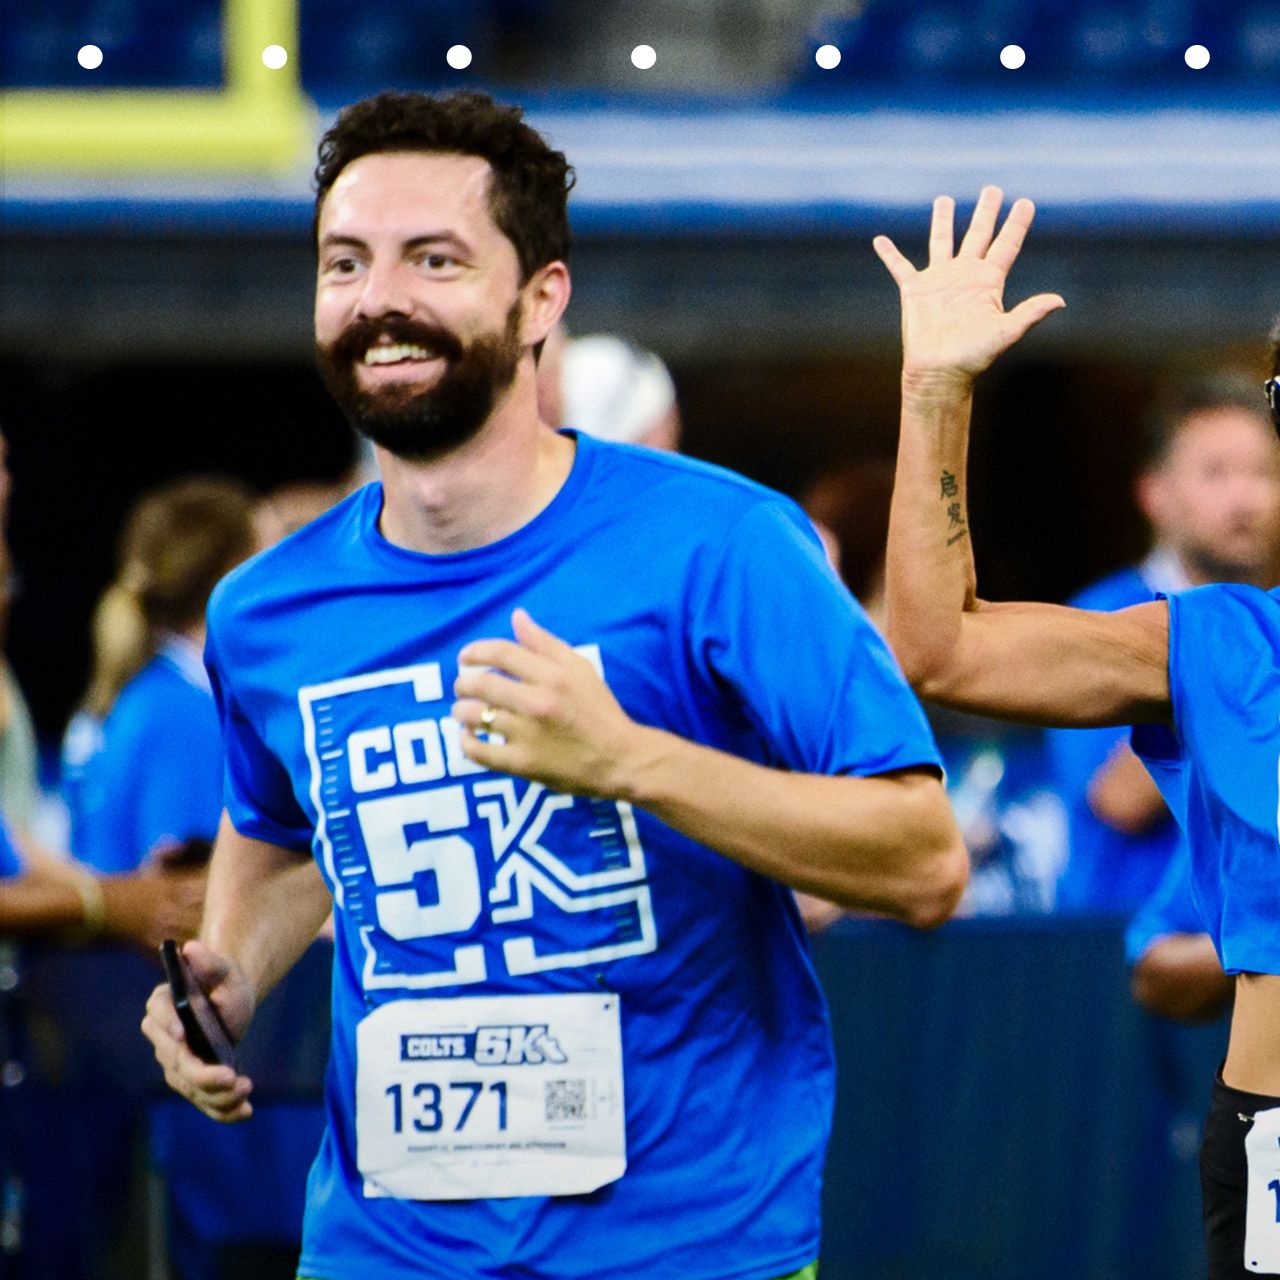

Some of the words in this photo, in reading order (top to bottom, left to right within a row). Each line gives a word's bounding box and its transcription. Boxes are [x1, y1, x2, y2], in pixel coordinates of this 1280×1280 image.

[347, 717, 506, 793] COL
[356, 777, 575, 942] 5K
[407, 1036, 467, 1059] COLTS
[475, 1024, 549, 1066] 5K
[385, 1081, 508, 1133] 1371
